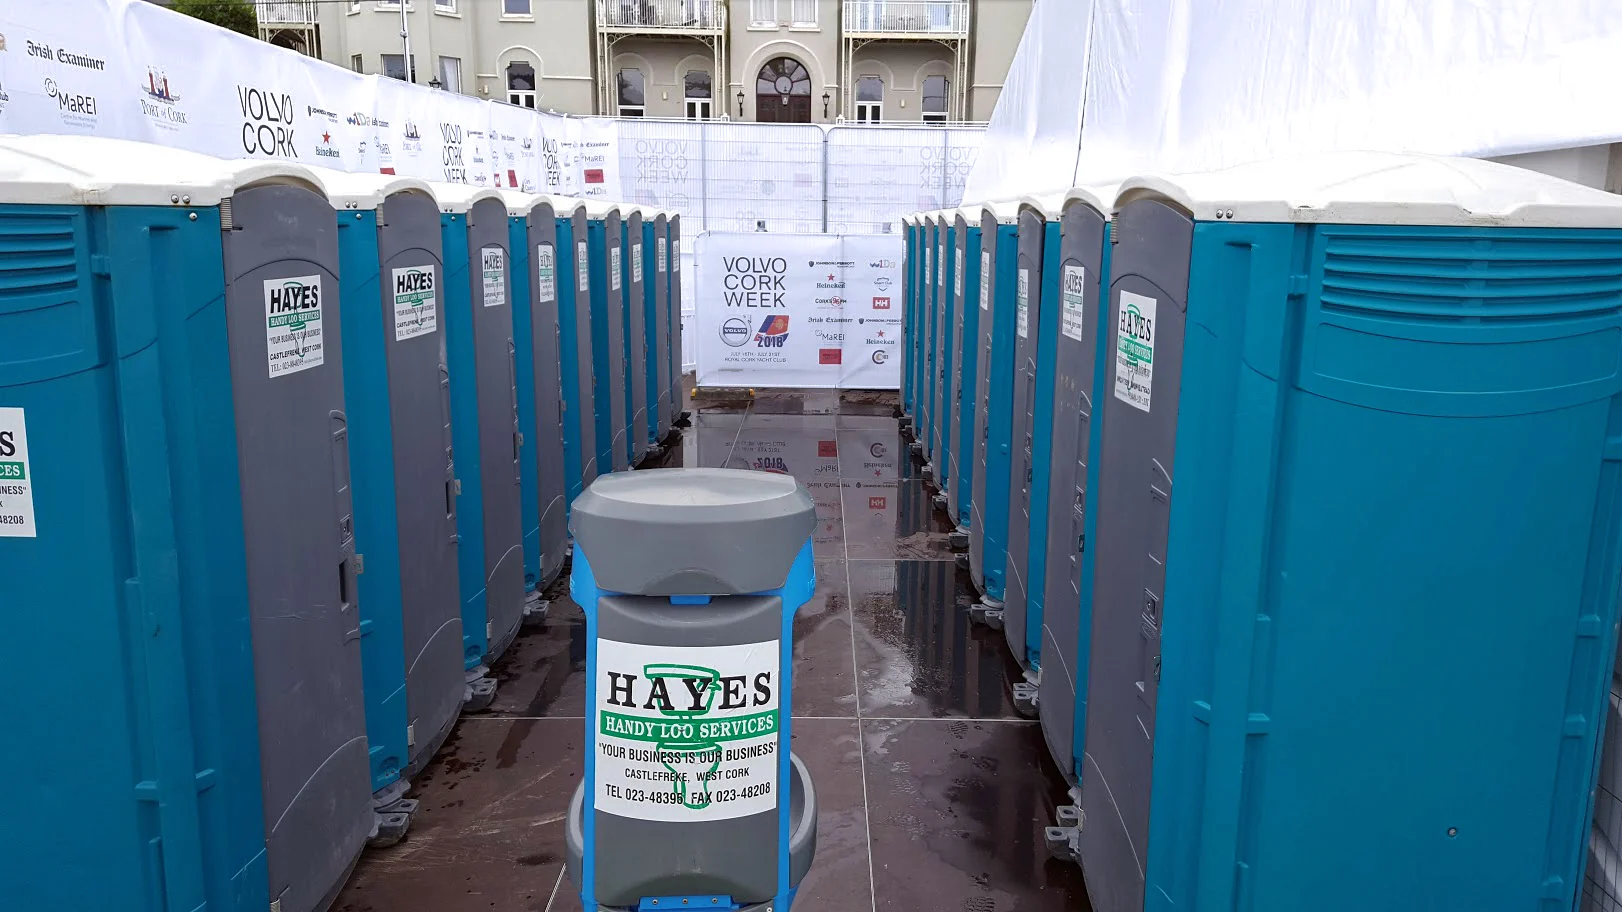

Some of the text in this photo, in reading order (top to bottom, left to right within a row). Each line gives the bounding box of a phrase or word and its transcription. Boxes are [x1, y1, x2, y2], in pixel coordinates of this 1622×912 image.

[26, 39, 105, 71] Irish Examiner
[58, 92, 97, 115] MaREI
[237, 84, 293, 125] VOLVO
[242, 122, 298, 158] CORK
[584, 155, 605, 163] MaREI
[484, 254, 503, 270] HAYES
[723, 256, 787, 274] VOLVO
[396, 271, 433, 294] HAYES
[724, 273, 786, 290] CORK
[816, 281, 846, 289] Heineken
[270, 284, 319, 315] HAYES
[723, 291, 786, 308] WEEK
[270, 309, 320, 327] HANDY LOO SERVICES
[1119, 310, 1151, 341] HAYES
[757, 335, 784, 348] 2018
[822, 333, 845, 341] MaREI
[270, 363, 282, 373] TEL:
[606, 671, 771, 711] HAYES
[605, 714, 774, 739] HANDY LOO SERVICES
[628, 748, 681, 764] BUSINESS
[685, 751, 696, 764] IS
[699, 750, 722, 764] OUR
[725, 741, 777, 762] BUSINESS"
[625, 766, 750, 784] CASTLEFREKE, WEST CORK
[605, 783, 622, 799] TEL
[691, 791, 713, 805] FAX
[716, 781, 771, 803] 023-48208
